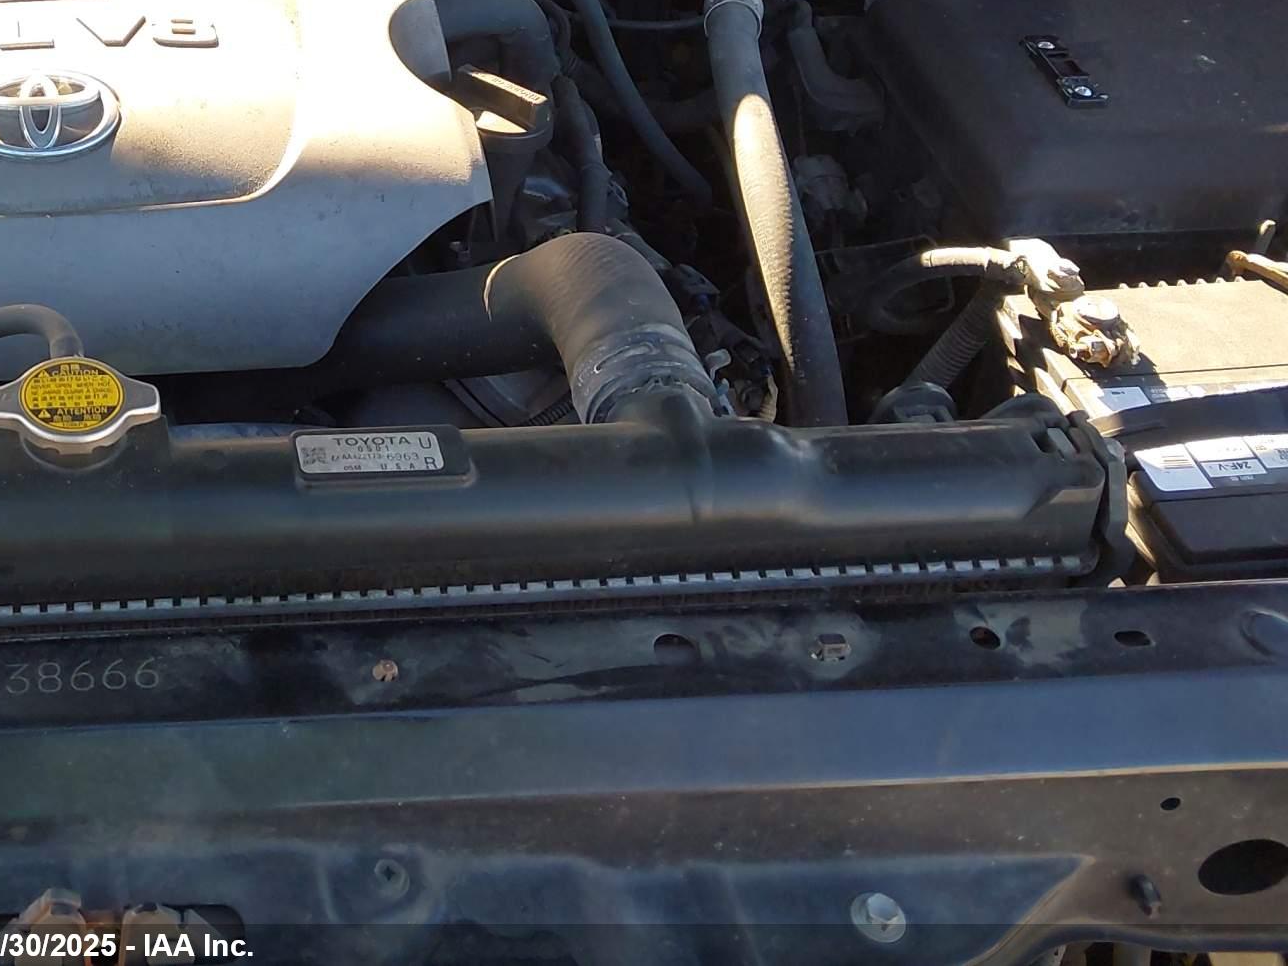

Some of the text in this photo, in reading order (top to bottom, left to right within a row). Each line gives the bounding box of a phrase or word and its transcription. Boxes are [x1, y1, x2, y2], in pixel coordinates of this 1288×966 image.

[76, 15, 219, 48] V8
[56, 407, 108, 415] ATTENTION
[333, 436, 432, 449] TOYOTA U
[424, 457, 438, 469] R
[6, 658, 159, 693] 38666
